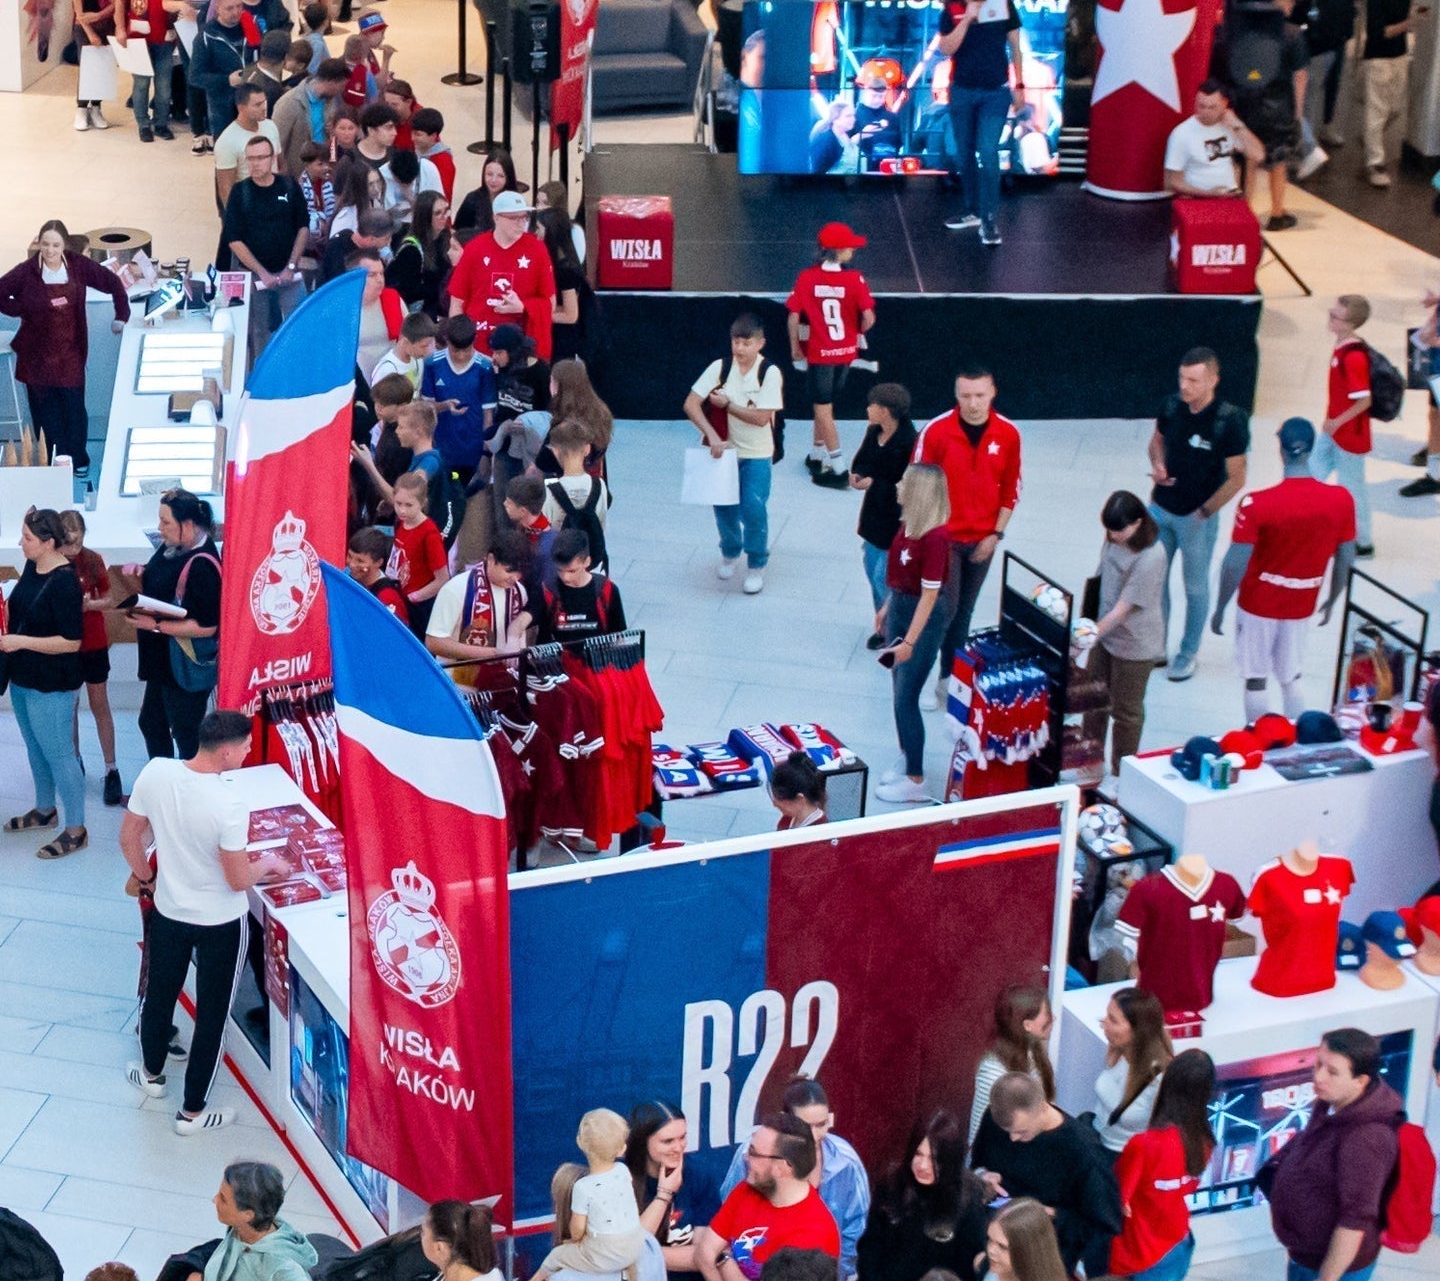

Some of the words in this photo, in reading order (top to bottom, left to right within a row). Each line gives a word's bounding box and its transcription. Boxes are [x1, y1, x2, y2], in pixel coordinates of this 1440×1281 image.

[611, 239, 663, 260] WISŁA
[1192, 244, 1247, 266] WISŁA
[822, 298, 846, 341] 9
[383, 1022, 462, 1073] WISŁA
[681, 979, 840, 1153] R22
